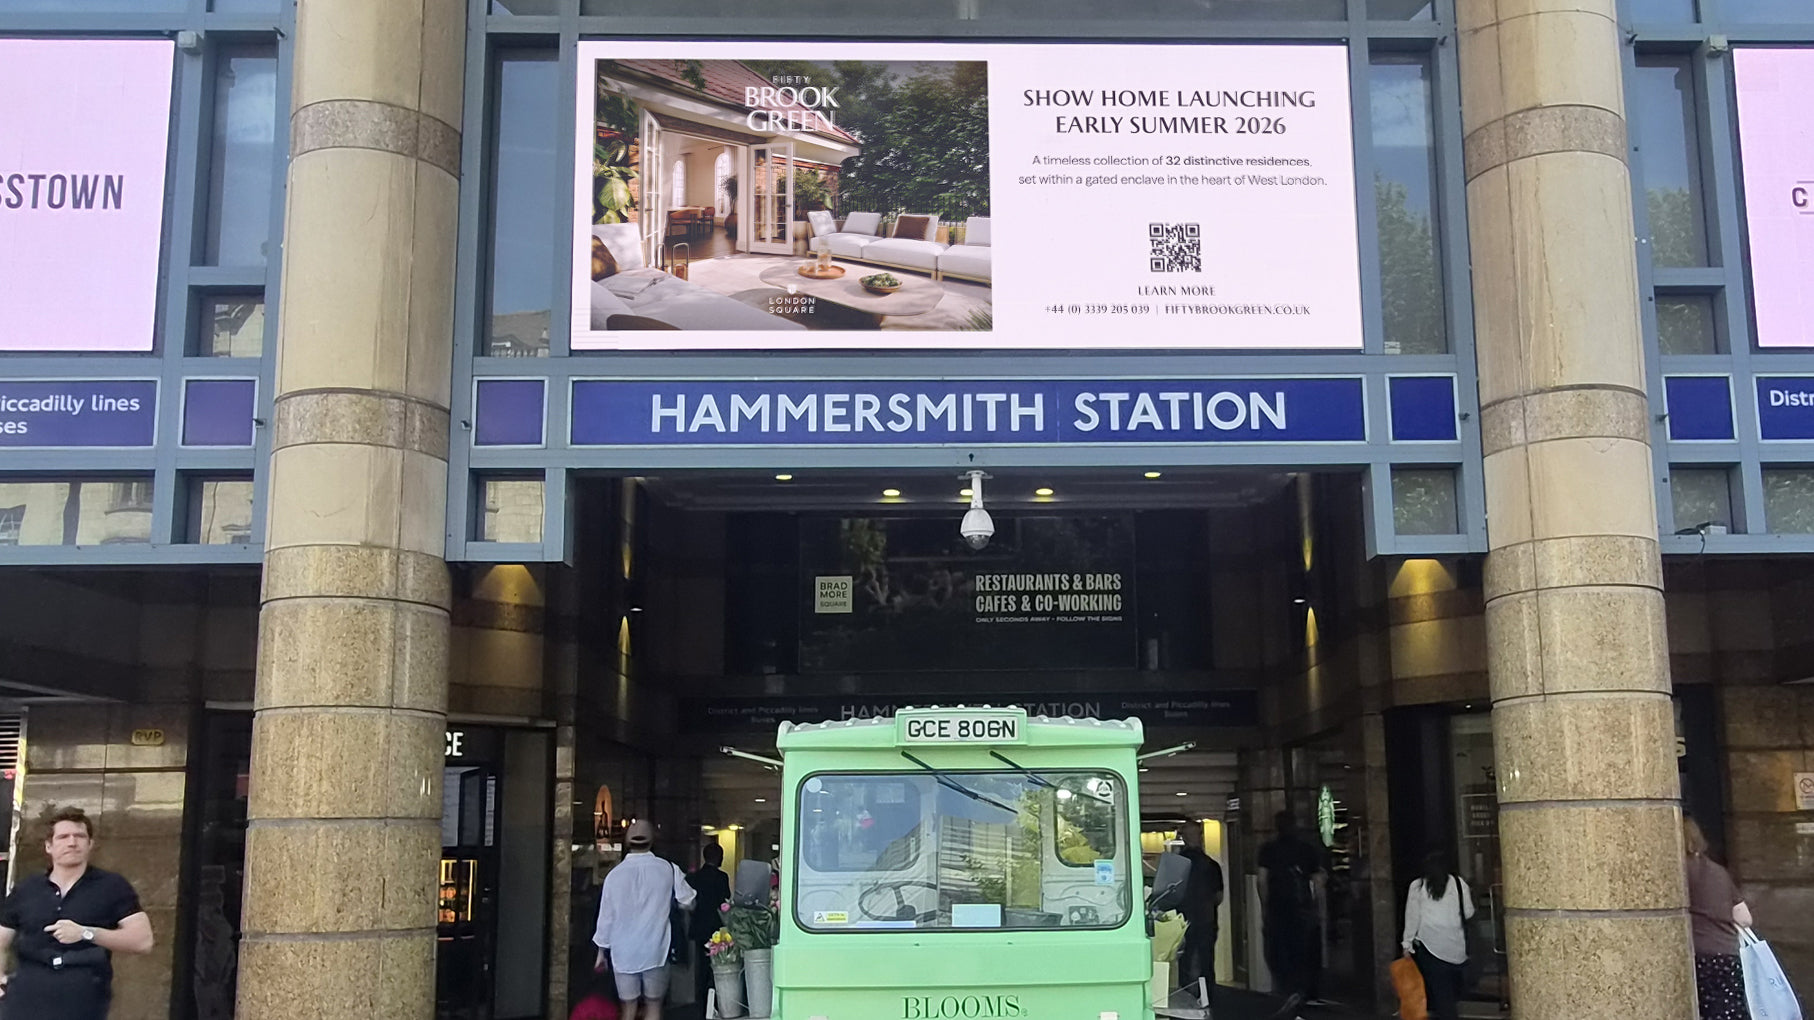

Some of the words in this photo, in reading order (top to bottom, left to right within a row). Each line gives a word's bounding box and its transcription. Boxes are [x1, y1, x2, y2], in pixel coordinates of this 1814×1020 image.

[772, 75, 810, 84] FIFTY
[744, 86, 840, 107] BROOK
[1023, 89, 1094, 106] SHOW
[1102, 90, 1170, 107] HOME
[1177, 90, 1316, 107] LAUNCHING
[746, 110, 836, 131] GREEN
[1056, 116, 1124, 133] EARLY
[1130, 116, 1229, 134] SUMMER
[1235, 117, 1287, 134] 2026
[1032, 155, 1042, 165] A
[1043, 155, 1091, 166] timeless
[1093, 155, 1150, 166] collection
[1152, 155, 1164, 166] of
[1165, 156, 1181, 166] 32
[1183, 155, 1244, 166] distinctive
[1018, 175, 1037, 185] set
[1039, 174, 1074, 185] within
[1075, 177, 1083, 185] a
[1085, 174, 1118, 187] gated
[1120, 174, 1165, 185] enclave
[1167, 174, 1178, 185] in
[1180, 174, 1199, 185] the
[1201, 174, 1232, 185] heart
[1234, 174, 1246, 185] of
[1247, 175, 1279, 186] West
[1280, 175, 1328, 186] London.
[0, 173, 124, 210] STOWN
[1138, 285, 1177, 296] LEARN
[1180, 286, 1217, 296] MORE
[768, 297, 815, 305] LONDON
[768, 306, 815, 314] SQUARE
[1045, 304, 1064, 314] +44
[1067, 304, 1081, 315] (0)
[1085, 304, 1108, 314] 3339
[1111, 304, 1129, 314] 205
[1131, 304, 1150, 314] 039
[1165, 304, 1311, 315] FIFTYBROOKGREEN.CO.UK
[91, 394, 140, 412] lines
[651, 393, 1044, 433] HAMMERSMITH
[1073, 391, 1287, 432] STATION
[820, 582, 848, 590] BRAD
[975, 573, 1070, 591] RESTAURANTS
[1072, 574, 1083, 590] &
[1086, 573, 1122, 590] BARS
[975, 595, 1017, 612] CAFES
[1021, 595, 1032, 611] &
[1035, 594, 1122, 611] CO-WORKING
[1016, 702, 1100, 718] TATION
[908, 720, 951, 738] GCE
[958, 720, 1016, 738] 806N
